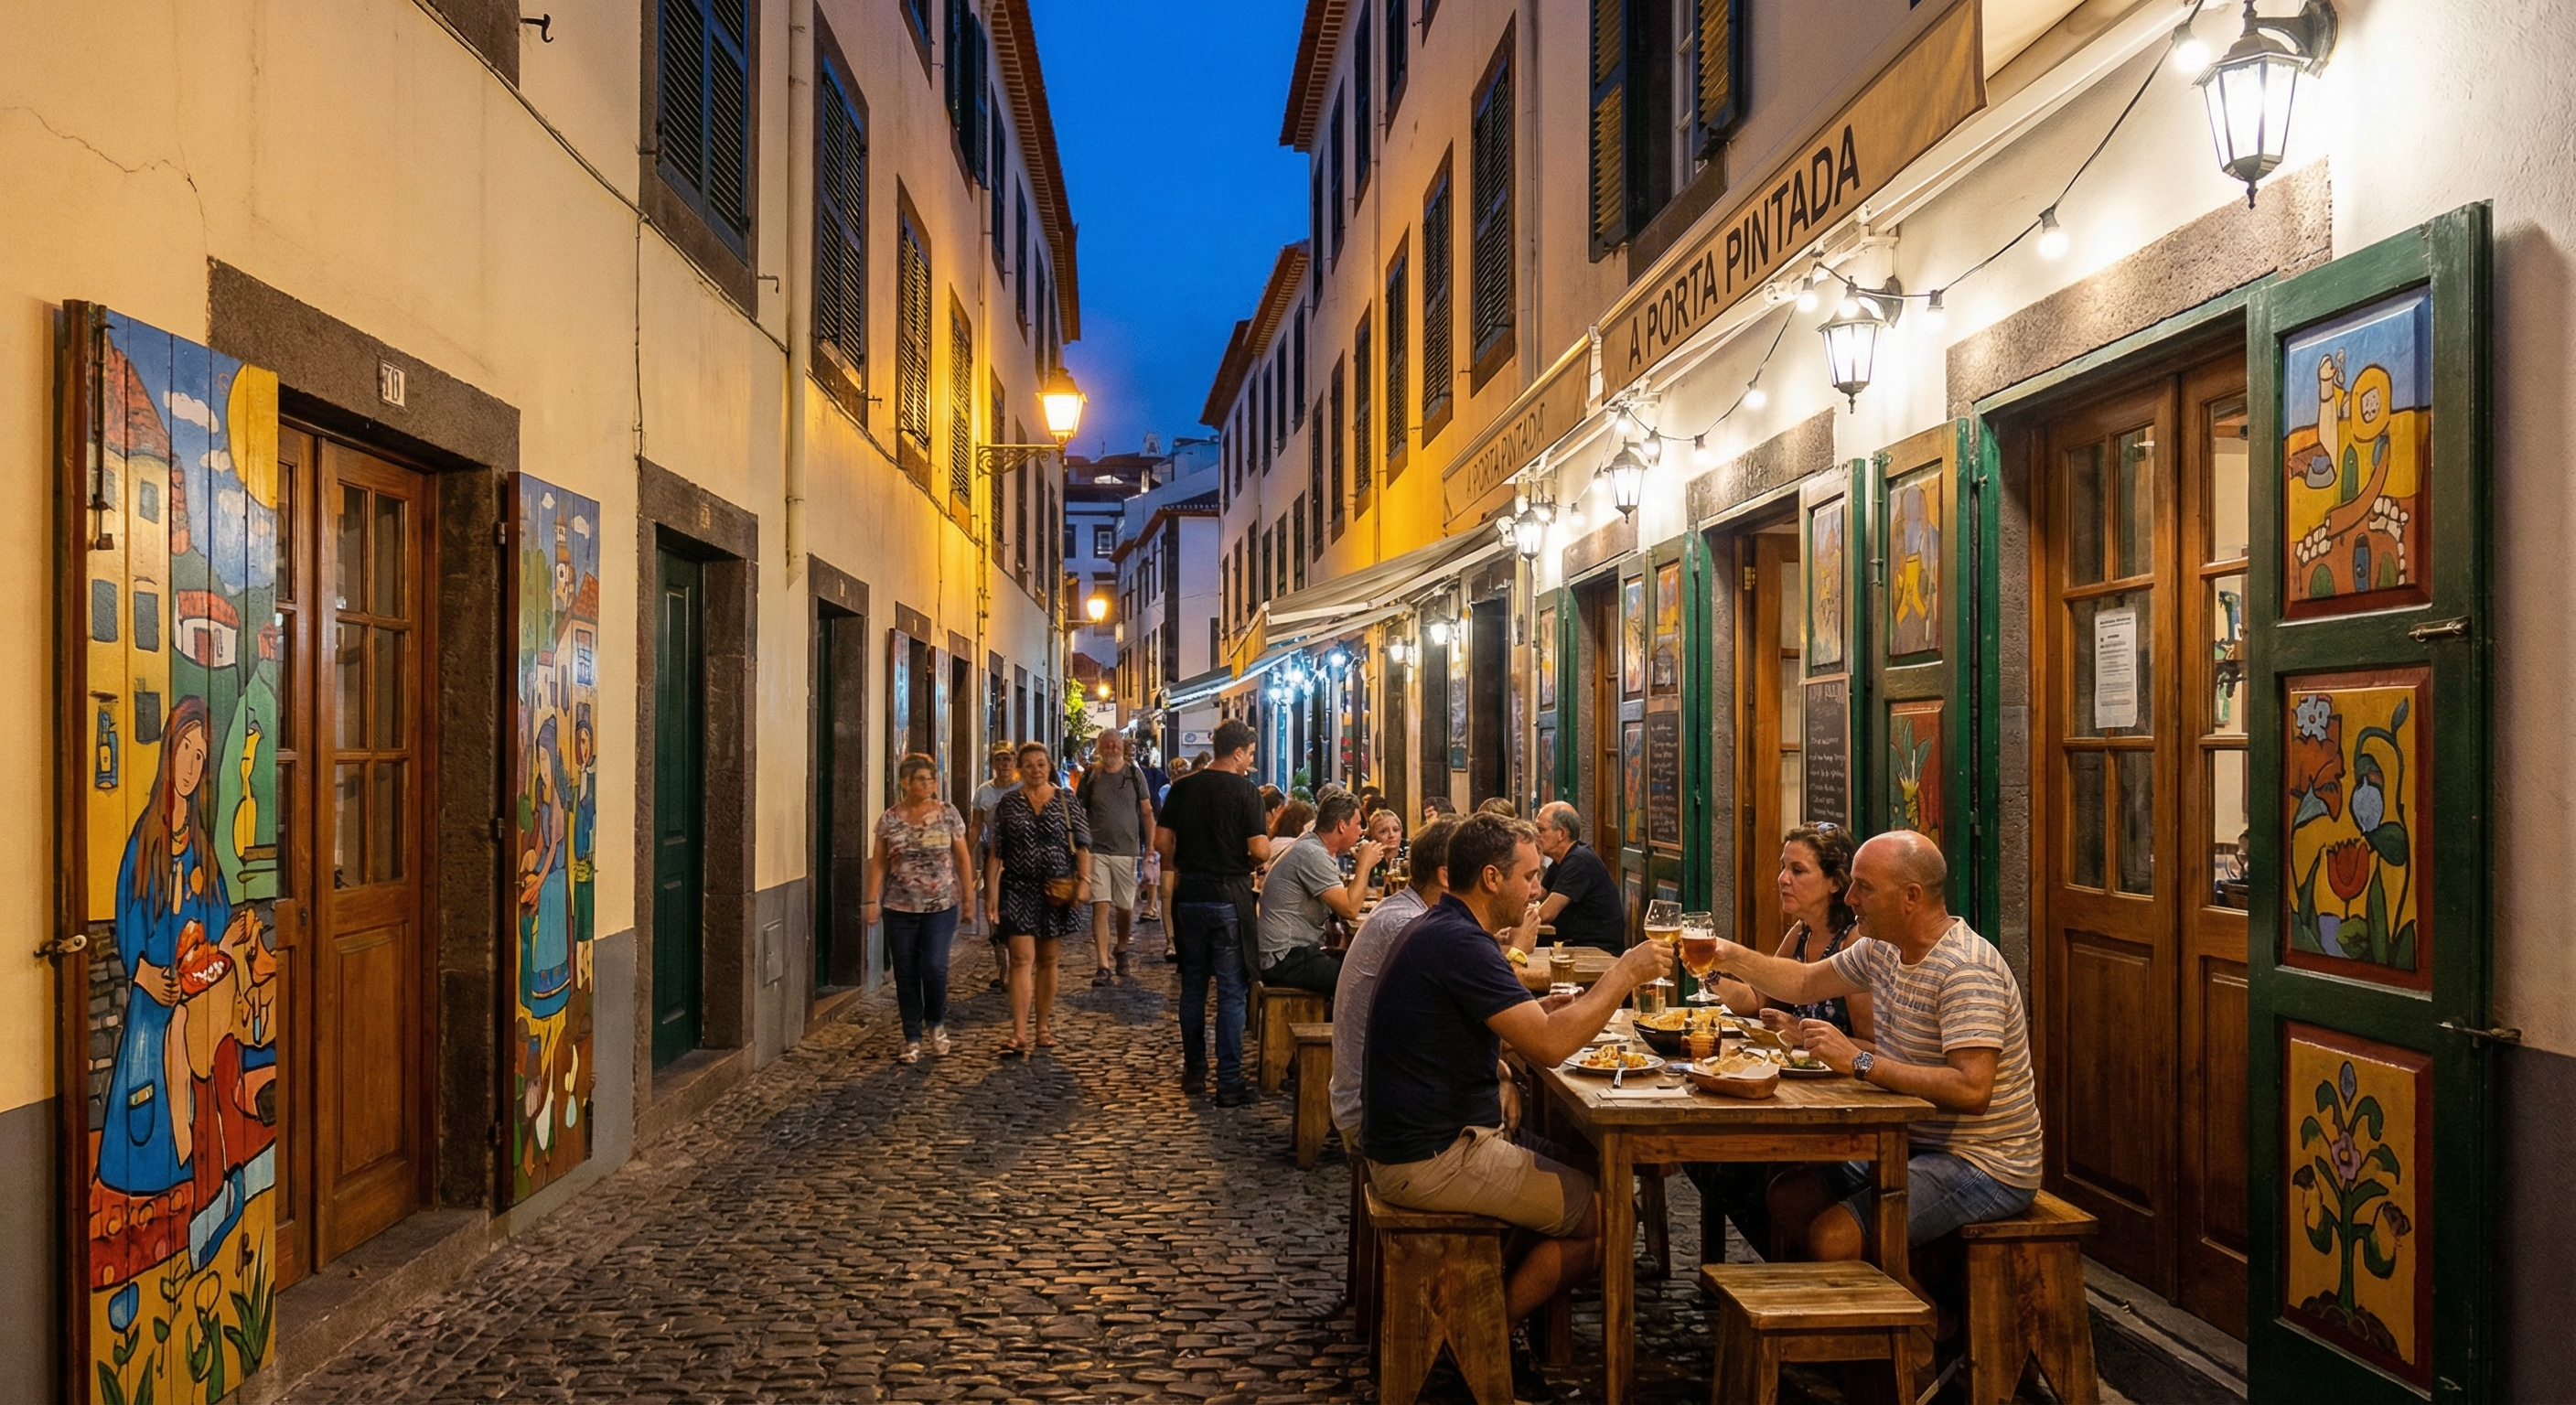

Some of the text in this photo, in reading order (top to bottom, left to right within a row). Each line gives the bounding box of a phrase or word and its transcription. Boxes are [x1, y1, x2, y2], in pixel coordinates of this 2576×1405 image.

[1628, 123, 1861, 372] A PORTA PINTADA
[1465, 467, 1473, 500] A
[1474, 444, 1500, 497] PORTA
